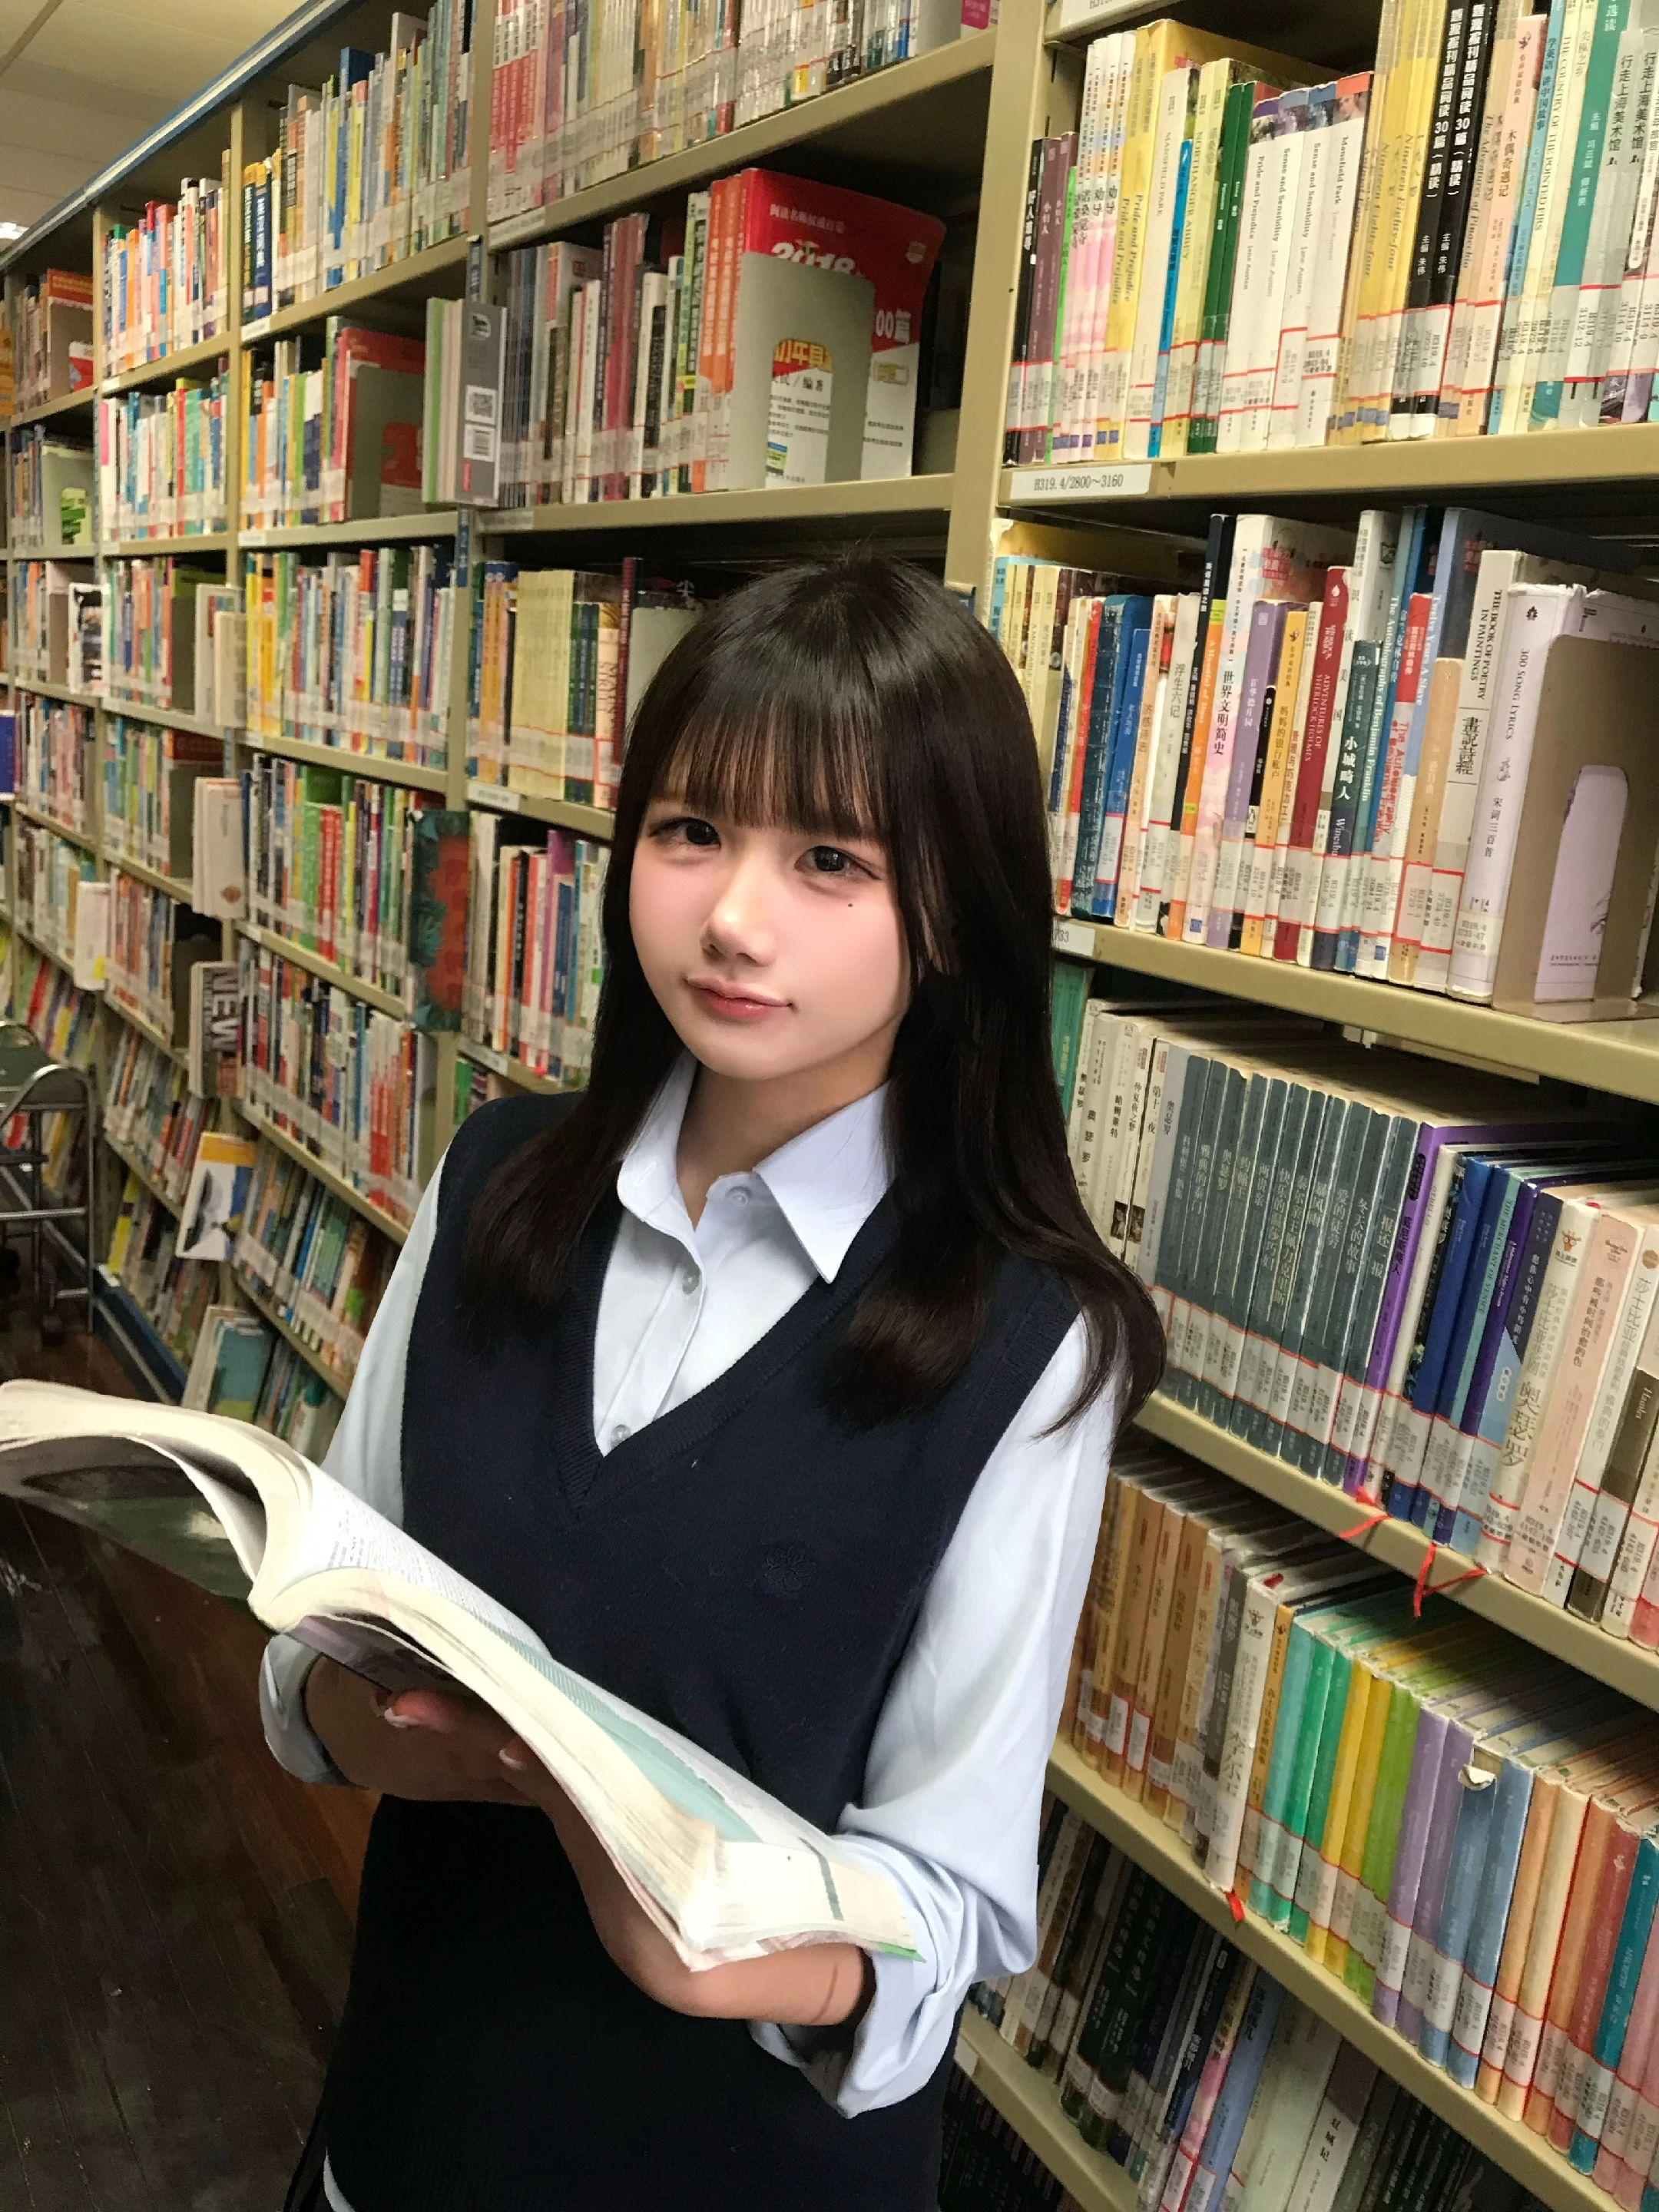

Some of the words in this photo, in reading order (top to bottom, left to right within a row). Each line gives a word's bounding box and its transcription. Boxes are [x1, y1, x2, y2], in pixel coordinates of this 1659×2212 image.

[1560, 35, 1571, 58] THE
[1552, 58, 1568, 113] COUNTRY
[1482, 114, 1494, 136] The
[1550, 114, 1560, 131] OF
[1310, 141, 1321, 169] Sense
[1336, 135, 1349, 183] Mansfield
[1545, 133, 1557, 157] THE
[1254, 154, 1265, 179] Pride
[1280, 147, 1290, 174] Sense
[1397, 134, 1412, 192] Nineteen
[1473, 139, 1490, 194] Adventures
[1253, 180, 1262, 197] and
[1278, 175, 1288, 193] and
[1308, 171, 1317, 188] and
[1538, 155, 1554, 206] POINTED
[1131, 194, 1144, 223] Pride
[1155, 190, 1166, 217] PARK
[1333, 184, 1343, 205] Park
[1469, 199, 1480, 212] of
[1118, 197, 1131, 227] Pride
[1247, 199, 1260, 240] Prejudice
[1272, 194, 1285, 242] Sensibility
[1302, 190, 1315, 238] Sensibility
[1535, 207, 1545, 232] FIRS
[1116, 230, 1126, 251] and
[1130, 227, 1140, 247] and
[1386, 195, 1404, 270] Eighty-four
[1462, 214, 1479, 269] Pinocchio
[1244, 245, 1253, 262] Jane
[1269, 250, 1278, 267] Jane
[1299, 245, 1308, 263] Jane
[1108, 253, 1124, 305] Prejudice
[1123, 251, 1137, 303] Prejudice
[1242, 263, 1251, 290] Austen
[1266, 269, 1275, 297] Austen
[1296, 266, 1306, 295] Austen
[1387, 596, 1400, 618] The
[1427, 593, 1442, 633] Twelve
[1492, 588, 1502, 609] THE
[1479, 608, 1488, 621] IN
[1485, 611, 1498, 643] BOOK
[1375, 618, 1396, 692] Autobiography
[1422, 634, 1435, 665] Years
[1469, 623, 1486, 682] PAINTINGS
[1483, 644, 1493, 659] OF
[1517, 647, 1530, 667] 300
[1420, 667, 1429, 675] A
[1476, 658, 1491, 700] POETRY
[1511, 669, 1525, 701] SONG
[1171, 663, 1186, 718] 浮生六记
[1307, 673, 1323, 723] SHERLOCK
[1313, 673, 1333, 734] ADVENTURES
[1374, 694, 1385, 706] of
[1415, 677, 1427, 706] Slave
[1214, 670, 1235, 756] 世界文明简史
[1505, 703, 1520, 742] LYRICS
[1303, 724, 1316, 762] HOLMES
[1313, 736, 1323, 749] OF
[1366, 707, 1383, 756] Benjamin
[1396, 721, 1409, 743] The
[1360, 757, 1376, 803] Franklin
[1346, 1197, 1368, 1274] 冬天的故事
[1486, 1217, 1508, 1267] MERCHANT
